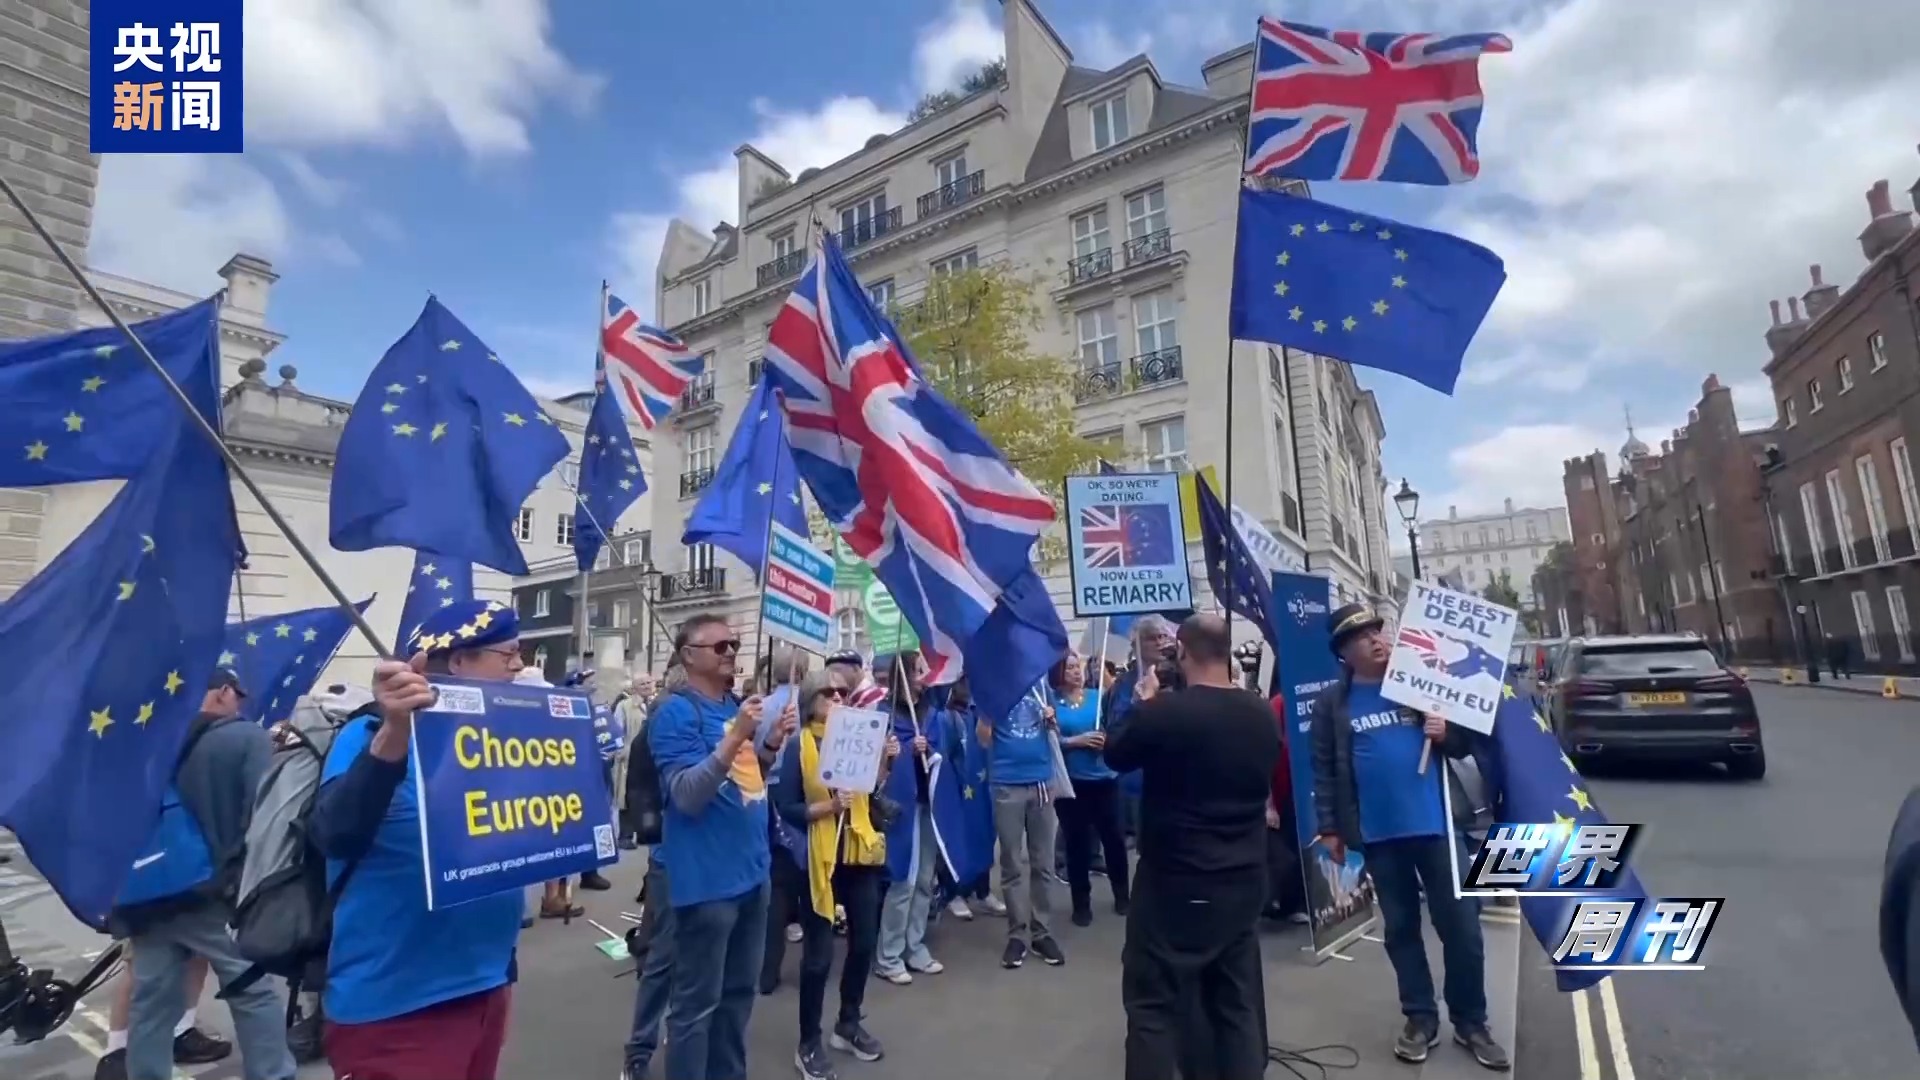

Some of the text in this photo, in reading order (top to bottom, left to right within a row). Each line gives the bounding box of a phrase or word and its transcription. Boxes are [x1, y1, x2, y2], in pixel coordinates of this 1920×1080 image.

[1108, 480, 1123, 489] SO
[1100, 571, 1128, 581] NOW
[1083, 583, 1184, 606] REMARRY
[1416, 584, 1513, 625] THE BEST
[1424, 603, 1492, 639] DEAL
[1388, 668, 1407, 684] IS
[1410, 674, 1461, 703] WITH
[1463, 692, 1495, 714] EU
[843, 717, 866, 735] WE
[454, 725, 576, 769] Choose
[833, 738, 874, 756] MISS
[464, 790, 583, 836] Europe
[443, 870, 459, 882] UK
